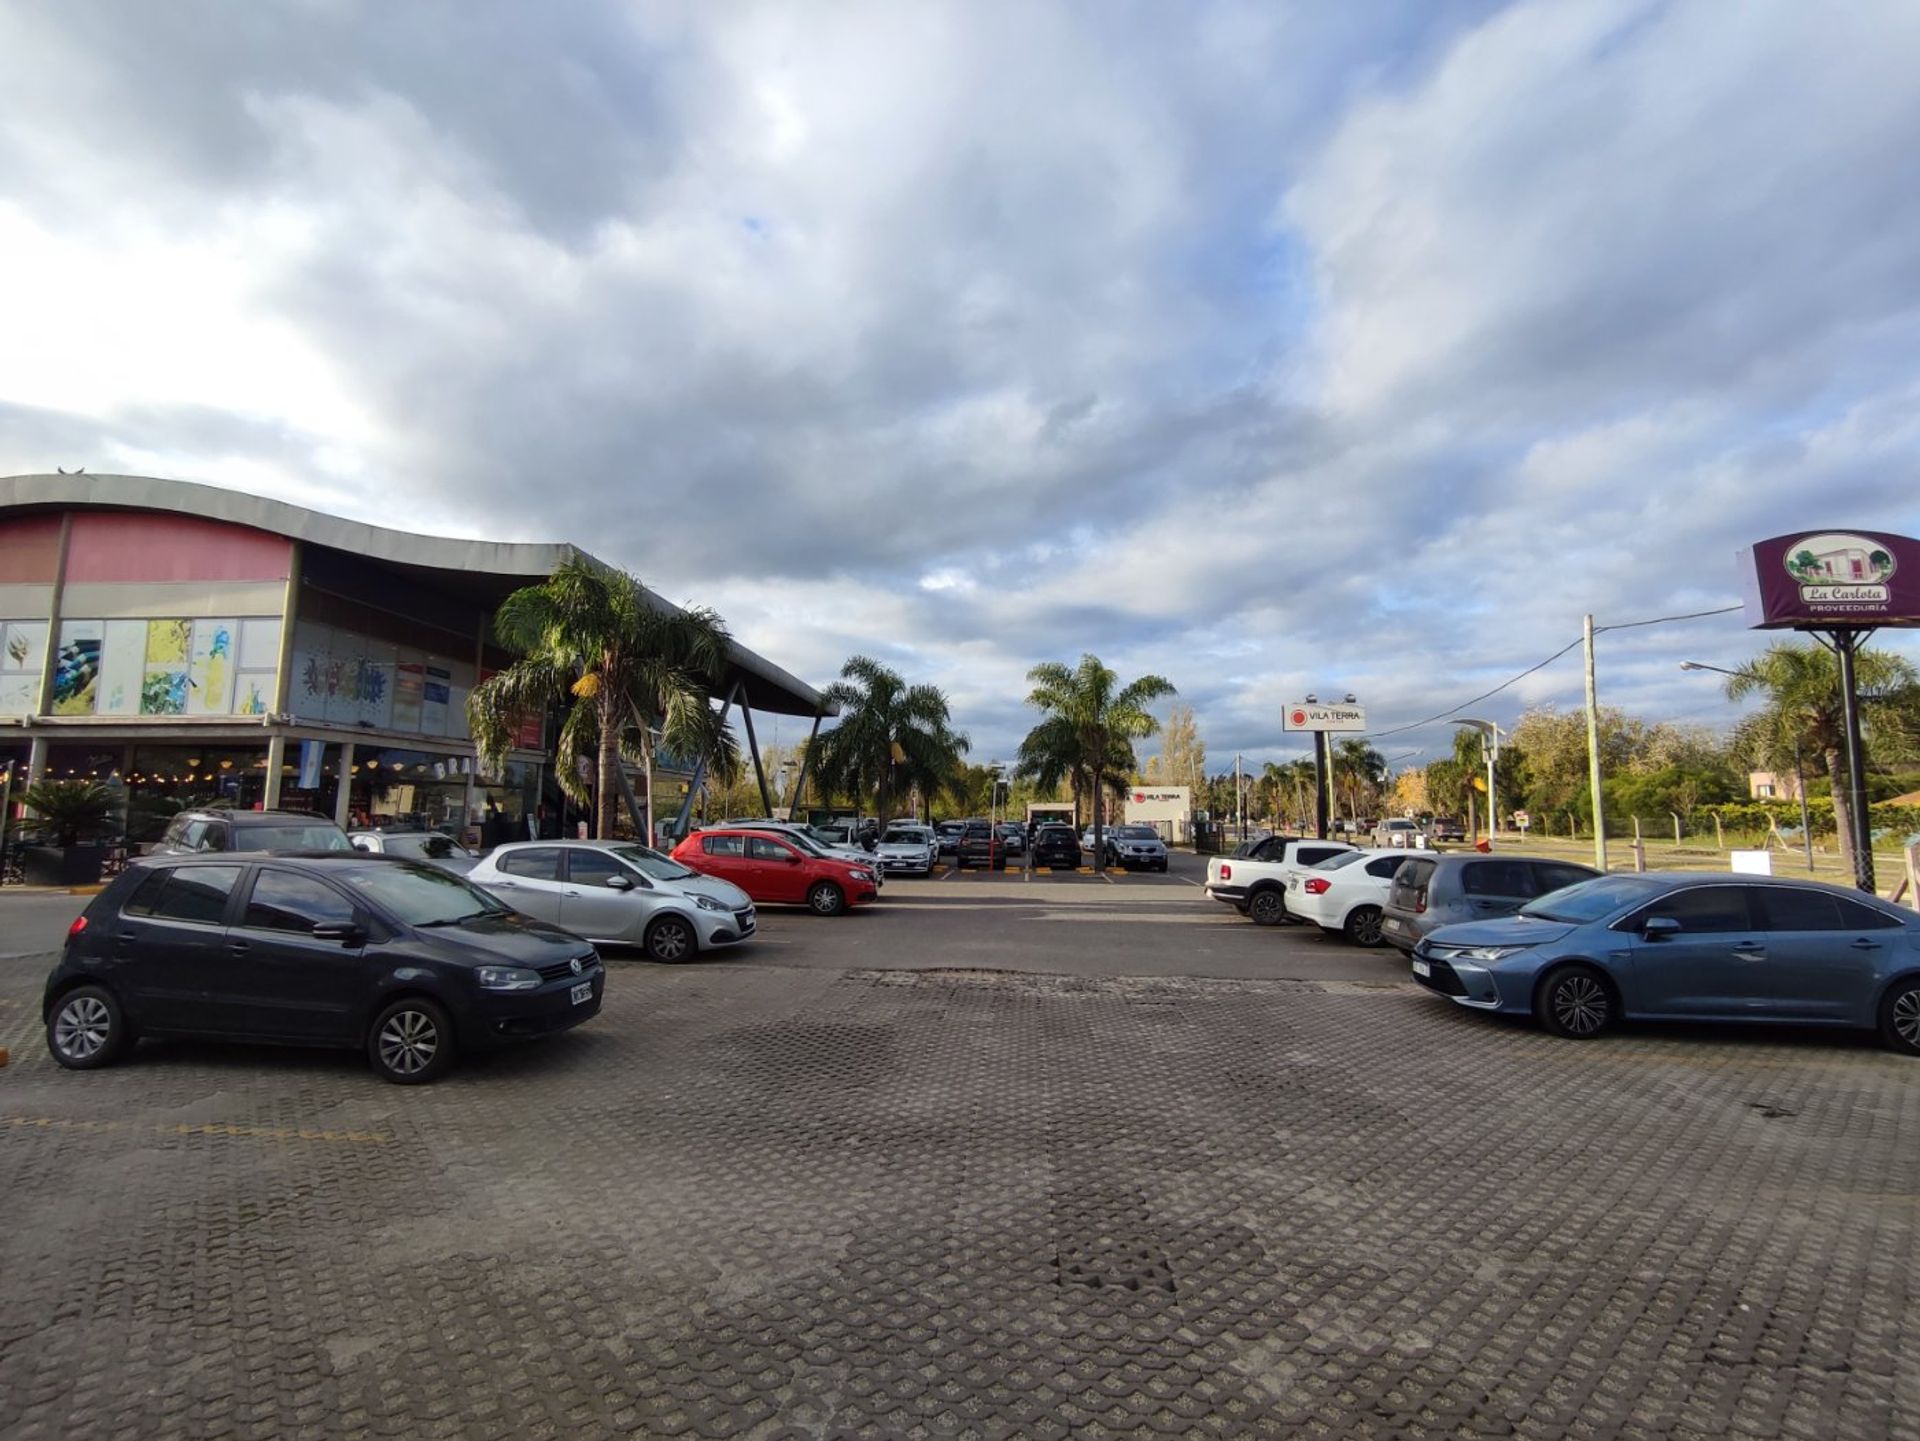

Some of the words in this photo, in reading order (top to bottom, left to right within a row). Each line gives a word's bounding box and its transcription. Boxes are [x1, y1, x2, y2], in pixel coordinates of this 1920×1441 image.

[1808, 587, 1828, 600] La
[1832, 586, 1881, 600] Carlota
[1309, 711, 1329, 720] VILA
[1330, 711, 1360, 720] TERRA
